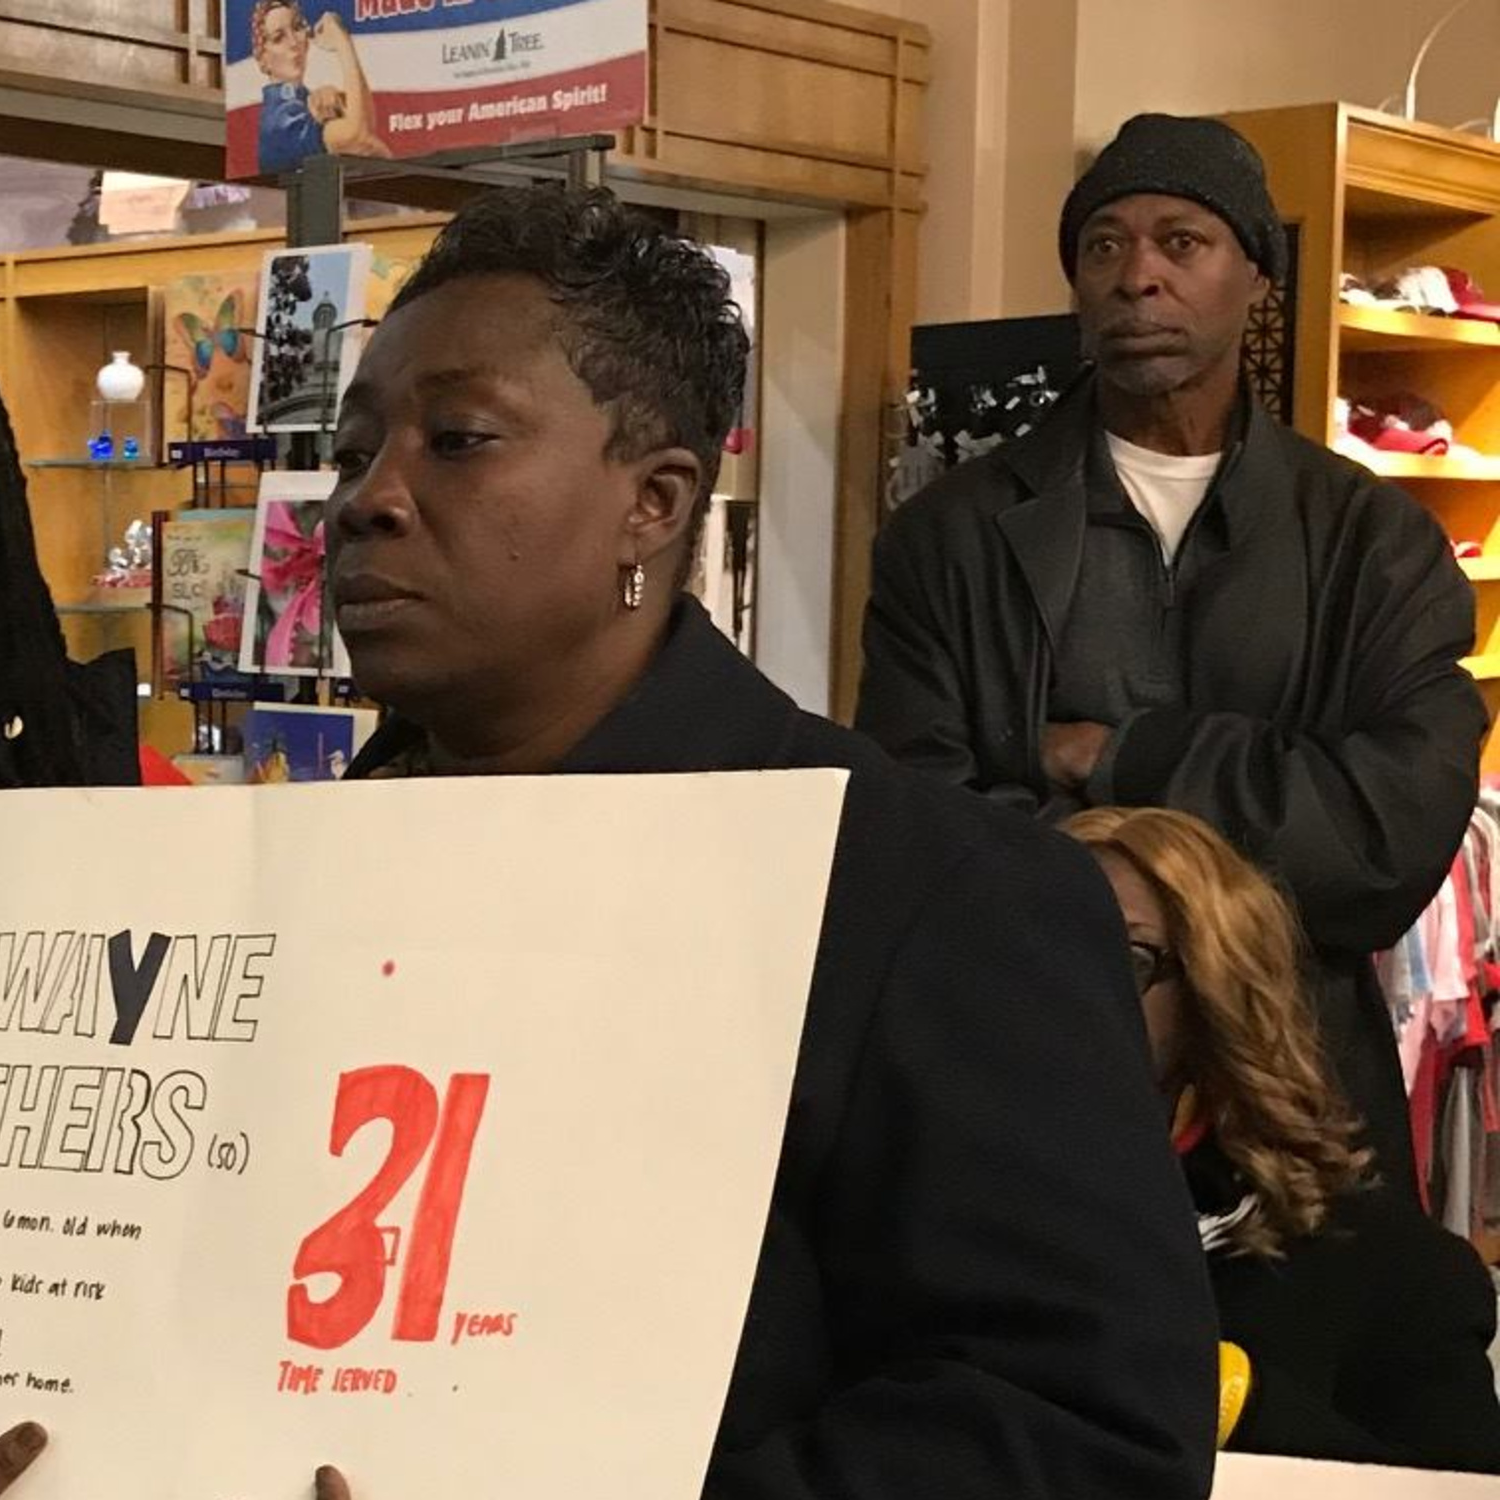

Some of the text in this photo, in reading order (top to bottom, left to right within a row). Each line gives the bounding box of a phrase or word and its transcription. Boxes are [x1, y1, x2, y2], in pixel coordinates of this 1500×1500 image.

[389, 83, 607, 132] Flex your American Spirit!
[96, 1220, 142, 1240] when
[47, 1278, 68, 1296] at
[277, 1360, 398, 1395] TIME SERVED
